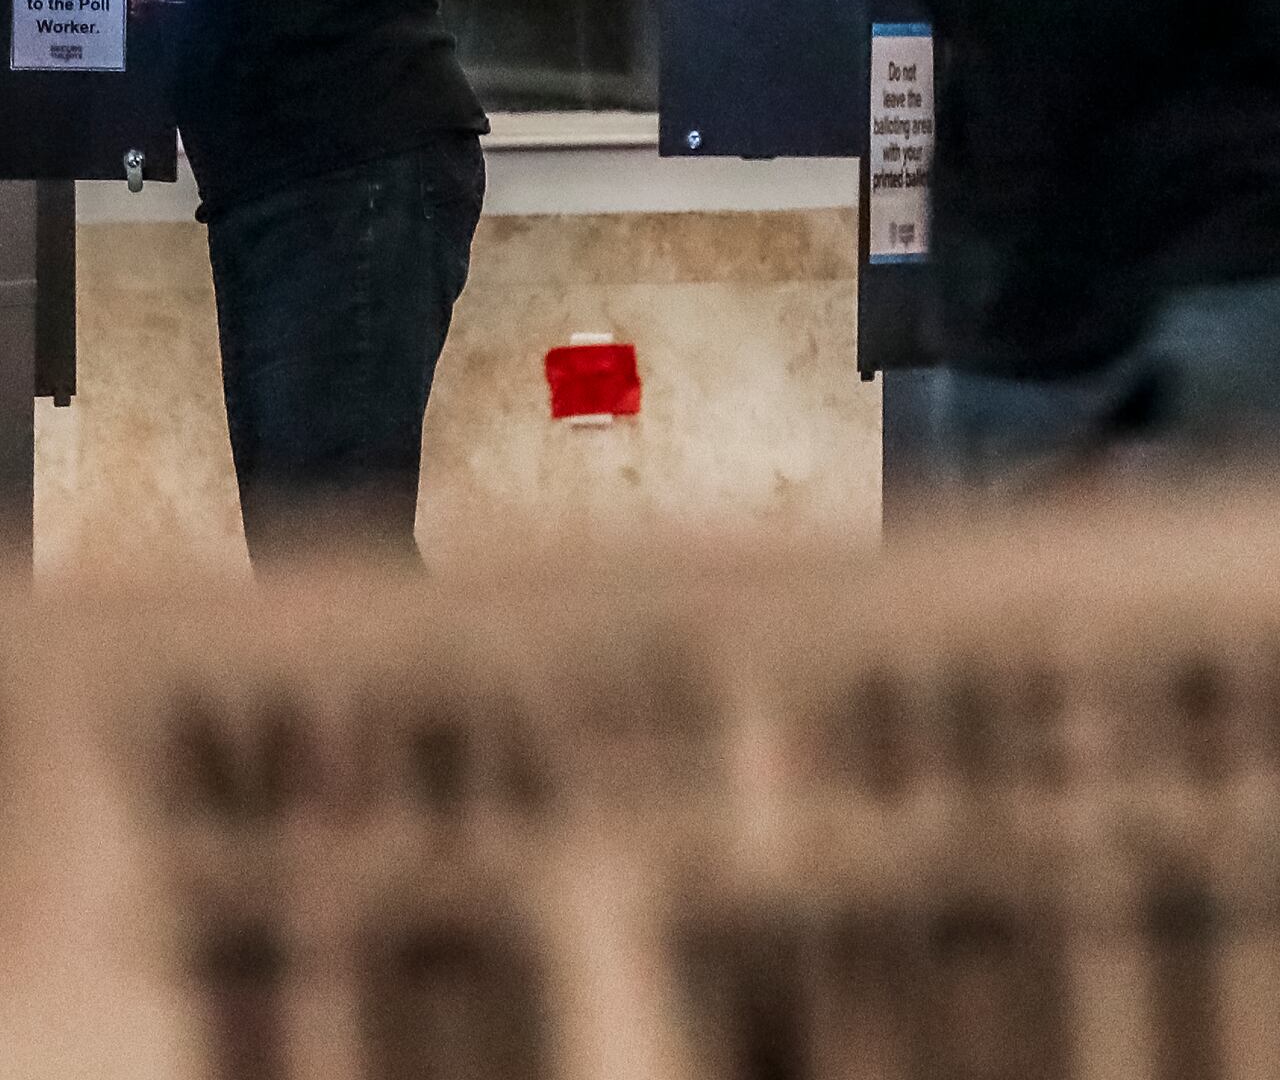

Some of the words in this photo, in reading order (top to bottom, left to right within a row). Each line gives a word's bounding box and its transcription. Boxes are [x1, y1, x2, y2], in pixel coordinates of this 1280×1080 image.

[36, 19, 100, 33] Worker.
[888, 61, 901, 82] Do
[902, 63, 917, 82] not
[883, 90, 906, 108] leave
[907, 91, 922, 108] the
[874, 117, 910, 140] balloting
[912, 119, 933, 135] area
[883, 143, 901, 162] with
[902, 146, 923, 166] your
[873, 170, 904, 194] printed
